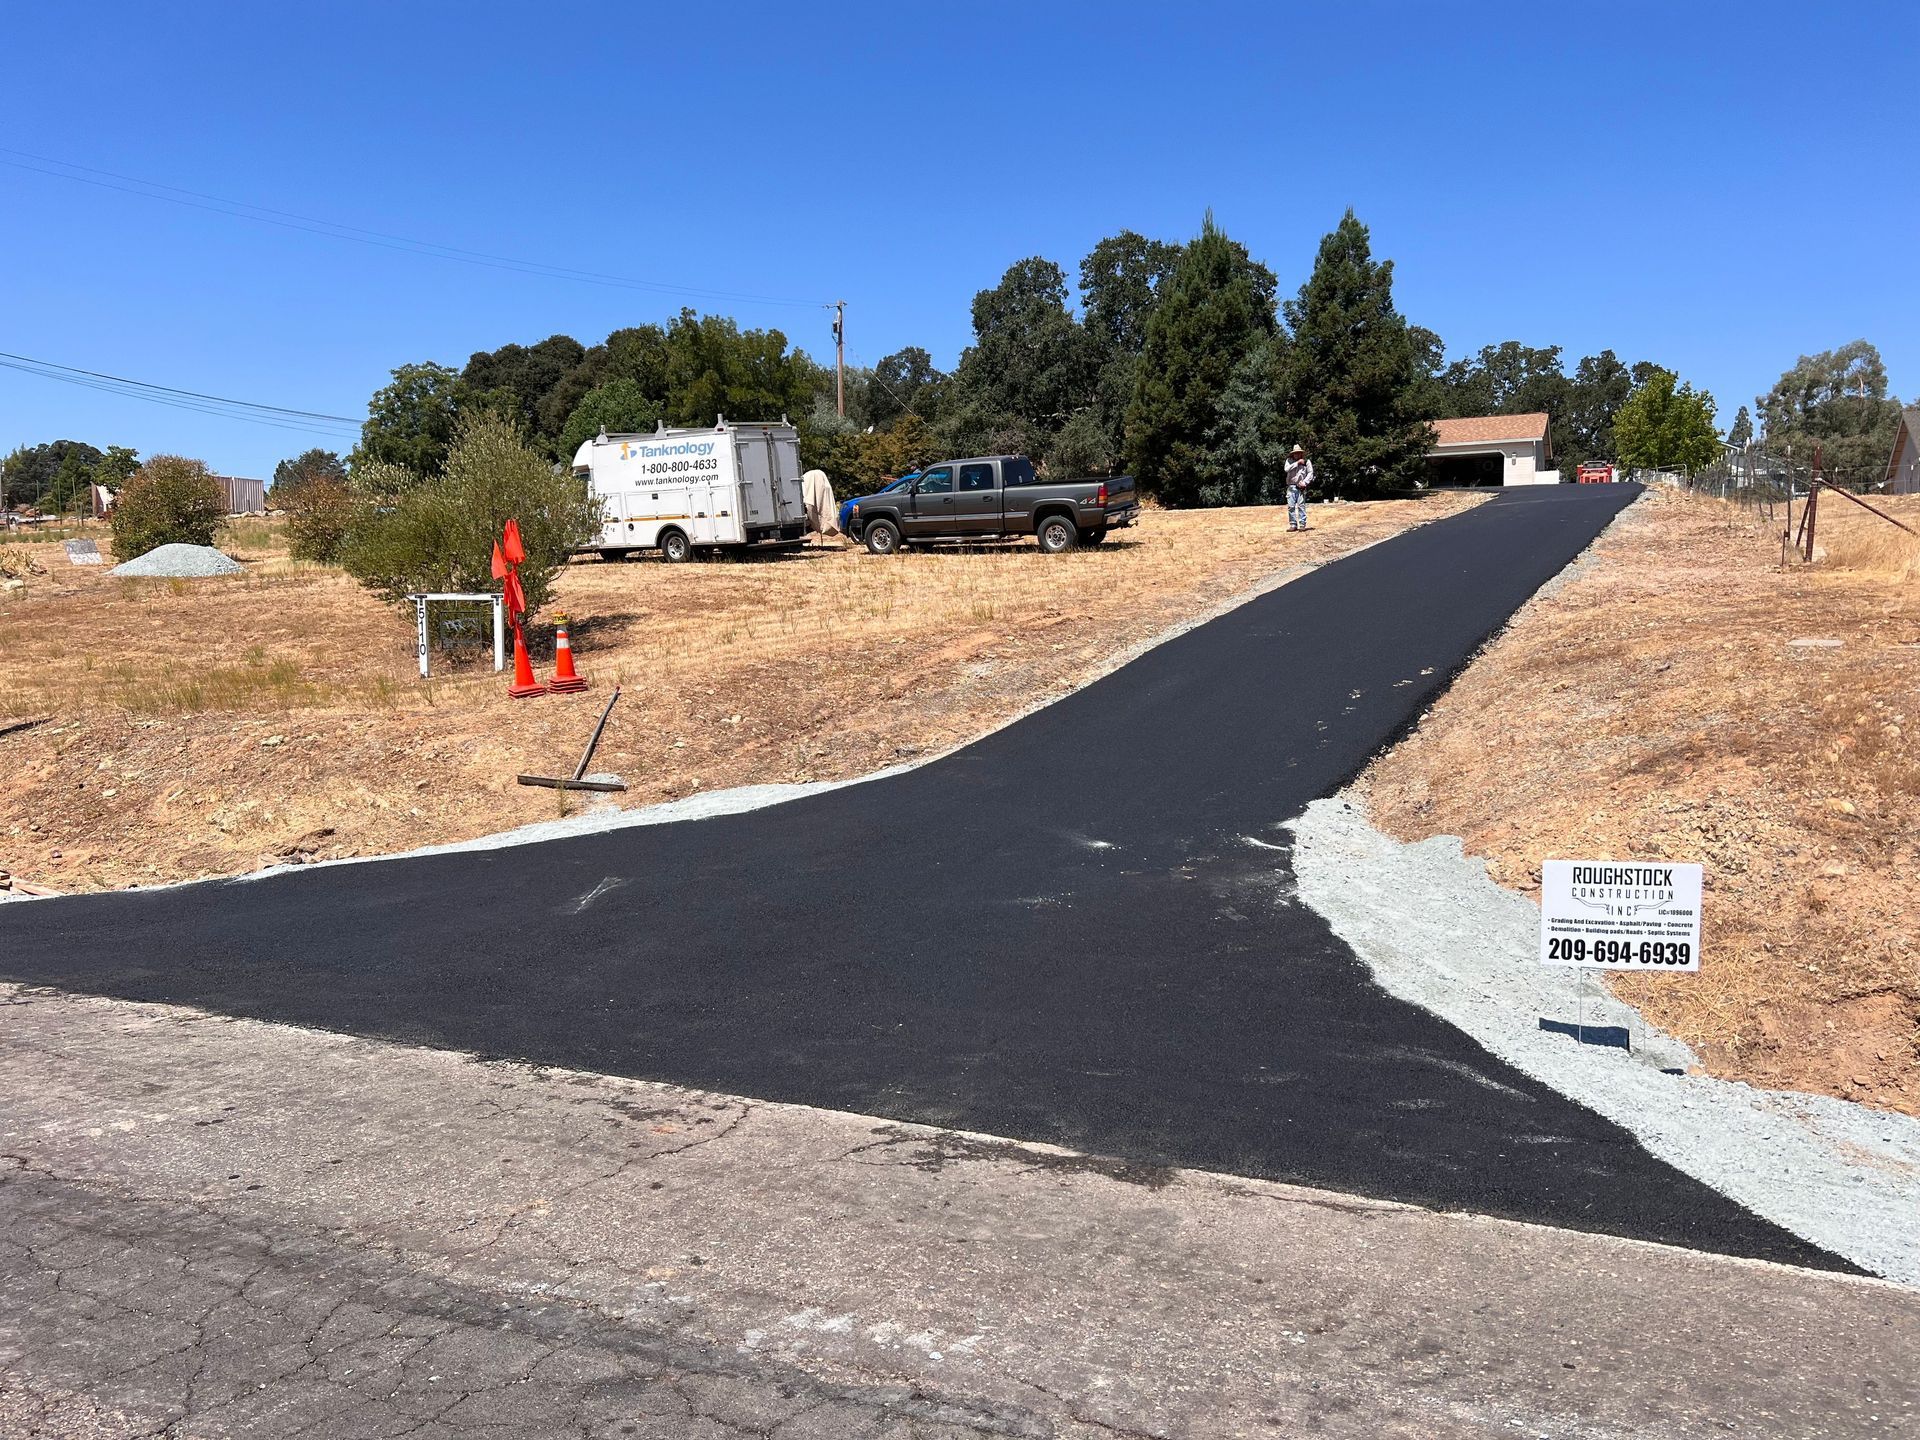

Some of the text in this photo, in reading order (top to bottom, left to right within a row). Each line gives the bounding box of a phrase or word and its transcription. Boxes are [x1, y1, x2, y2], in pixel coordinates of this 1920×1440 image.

[640, 442, 715, 457] Tanknology
[641, 459, 717, 474] 1-800-800-4633
[634, 474, 718, 486] www.tanknology.com
[418, 608, 426, 655] 5110
[1573, 867, 1673, 887] ROUGHSTOCK
[1572, 887, 1674, 900] CONSTRUCTION
[1611, 905, 1632, 917] INC
[1619, 920, 1662, 928] Asphalt/Paving
[1548, 938, 1690, 965] 209-694-6939
